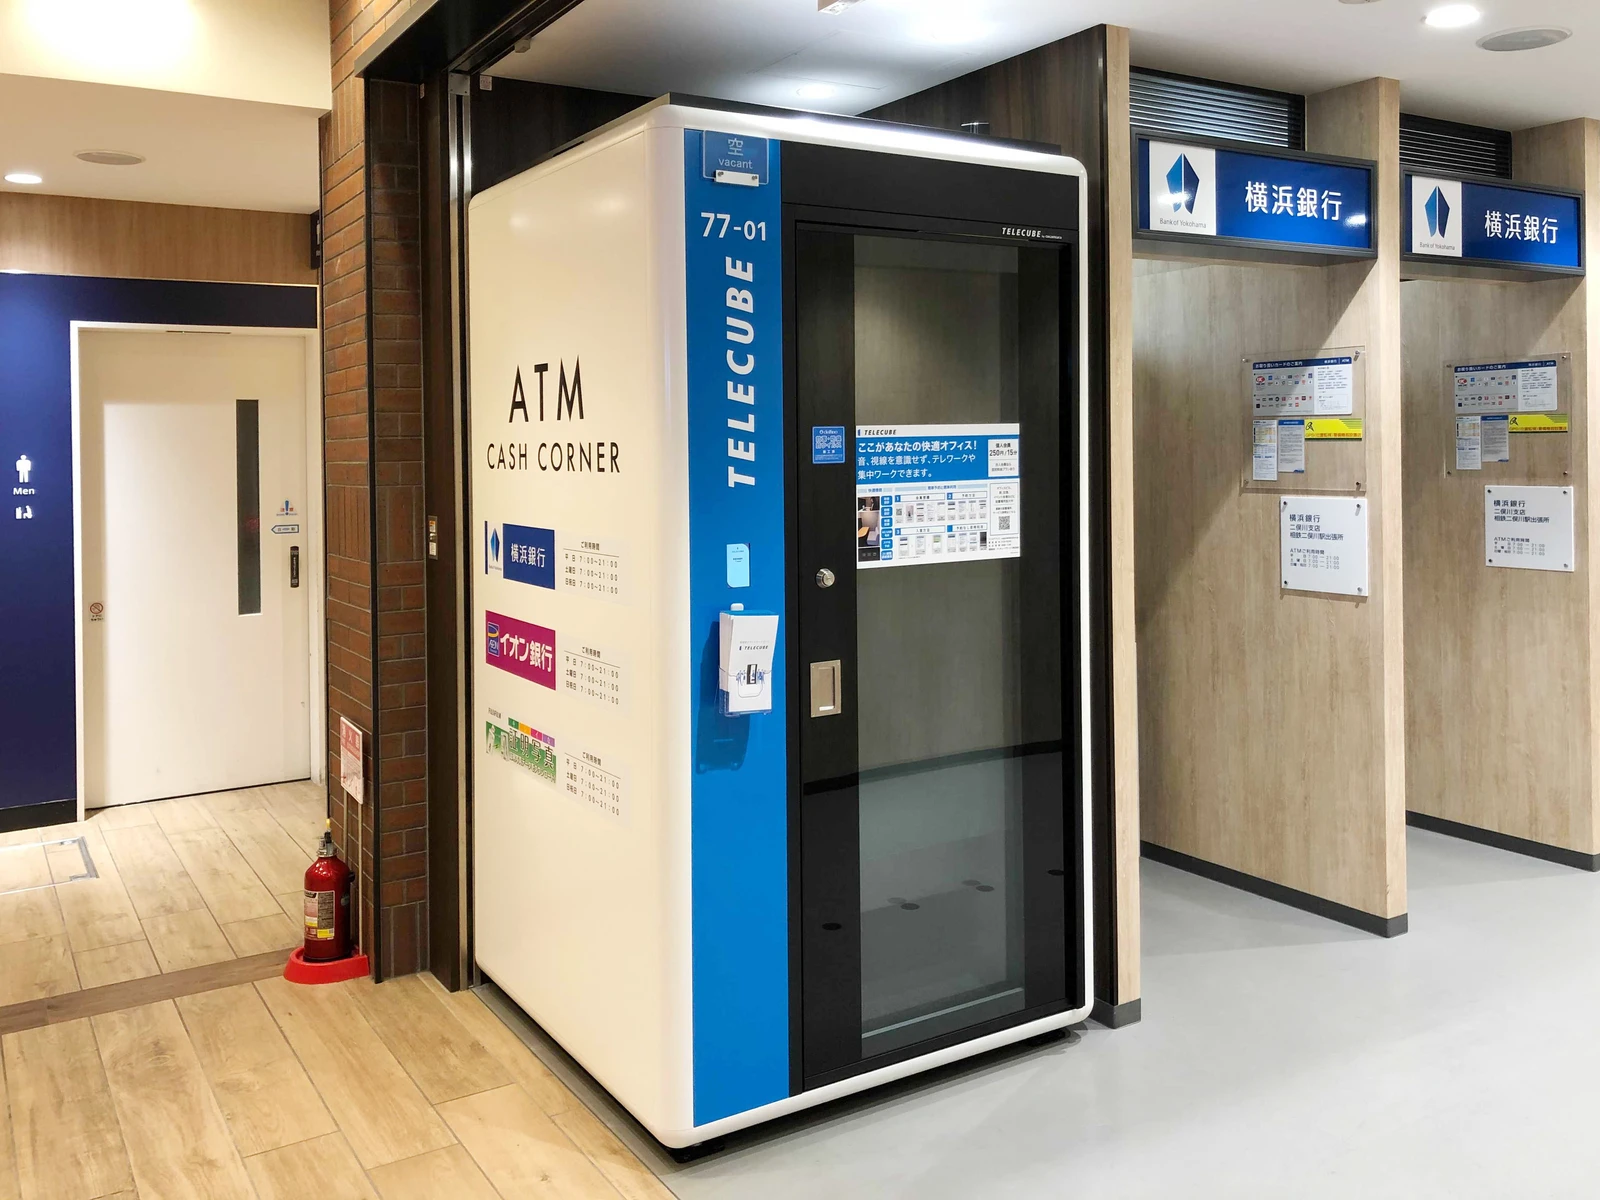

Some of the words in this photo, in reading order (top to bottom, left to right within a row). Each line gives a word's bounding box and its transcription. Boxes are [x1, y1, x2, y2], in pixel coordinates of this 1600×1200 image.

[728, 138, 744, 156] 空
[718, 158, 753, 169] vacant
[1244, 181, 1342, 221] 横浜銀行
[700, 212, 766, 241] 77-01
[1002, 227, 1041, 238] TELECUBE
[1160, 218, 1172, 226] Bank
[1180, 220, 1206, 228] Yokohama
[1484, 210, 1558, 244] 横浜銀行
[725, 256, 756, 488] TELECUBE
[509, 354, 584, 423] ATM
[487, 443, 527, 470] CASH
[538, 442, 620, 473] CORNER
[858, 454, 976, 466] 音、視線を意識せず、テレワークや
[858, 468, 932, 480] 集中ワークできます。
[1289, 514, 1320, 523] 横浜銀行
[1290, 532, 1344, 541] 相鉄二俣川駅出張所
[510, 543, 546, 568] 横浜銀行
[500, 633, 553, 672] イオン銀行
[509, 728, 555, 770] 証明写真
